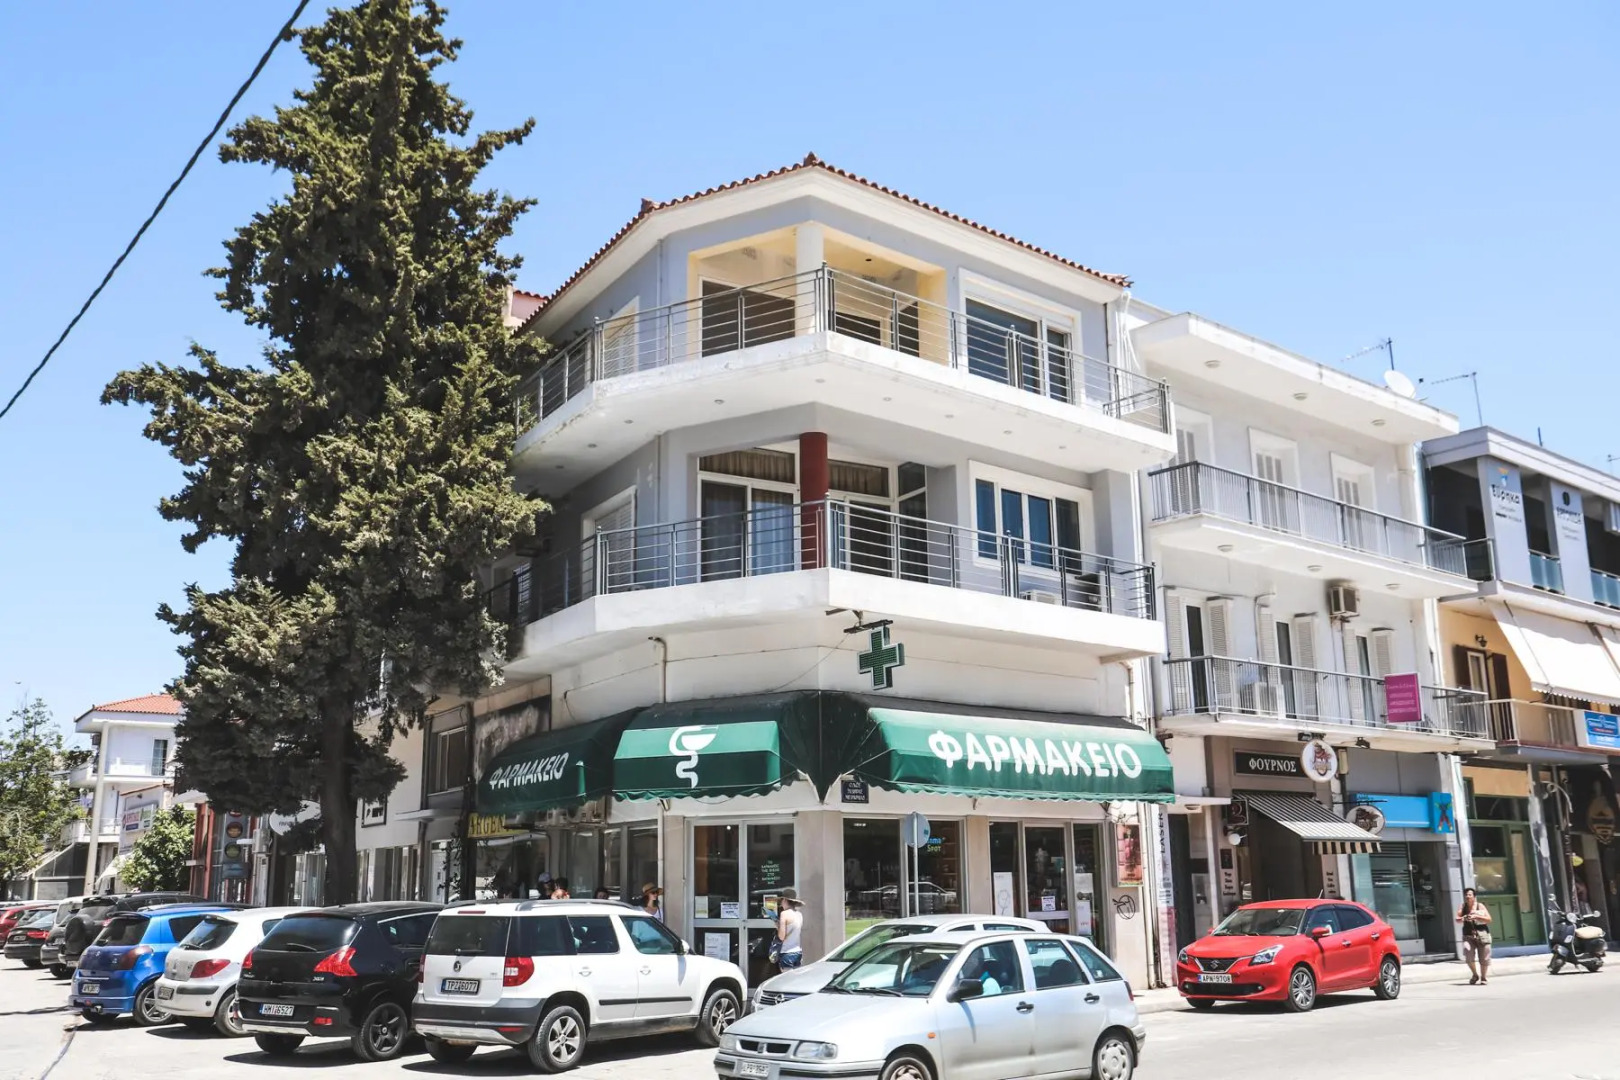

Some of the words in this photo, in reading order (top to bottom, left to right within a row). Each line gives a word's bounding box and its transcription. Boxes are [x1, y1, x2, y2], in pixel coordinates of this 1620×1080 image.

[489, 752, 569, 790] ΦΑΡΜΑΚΕΙΟ
[928, 730, 1142, 779] ΦΑΡΜΑΚΕΙΟ
[1248, 758, 1297, 772] ΦΟΥΡΝΟΣ
[1158, 812, 1166, 854] LASER
